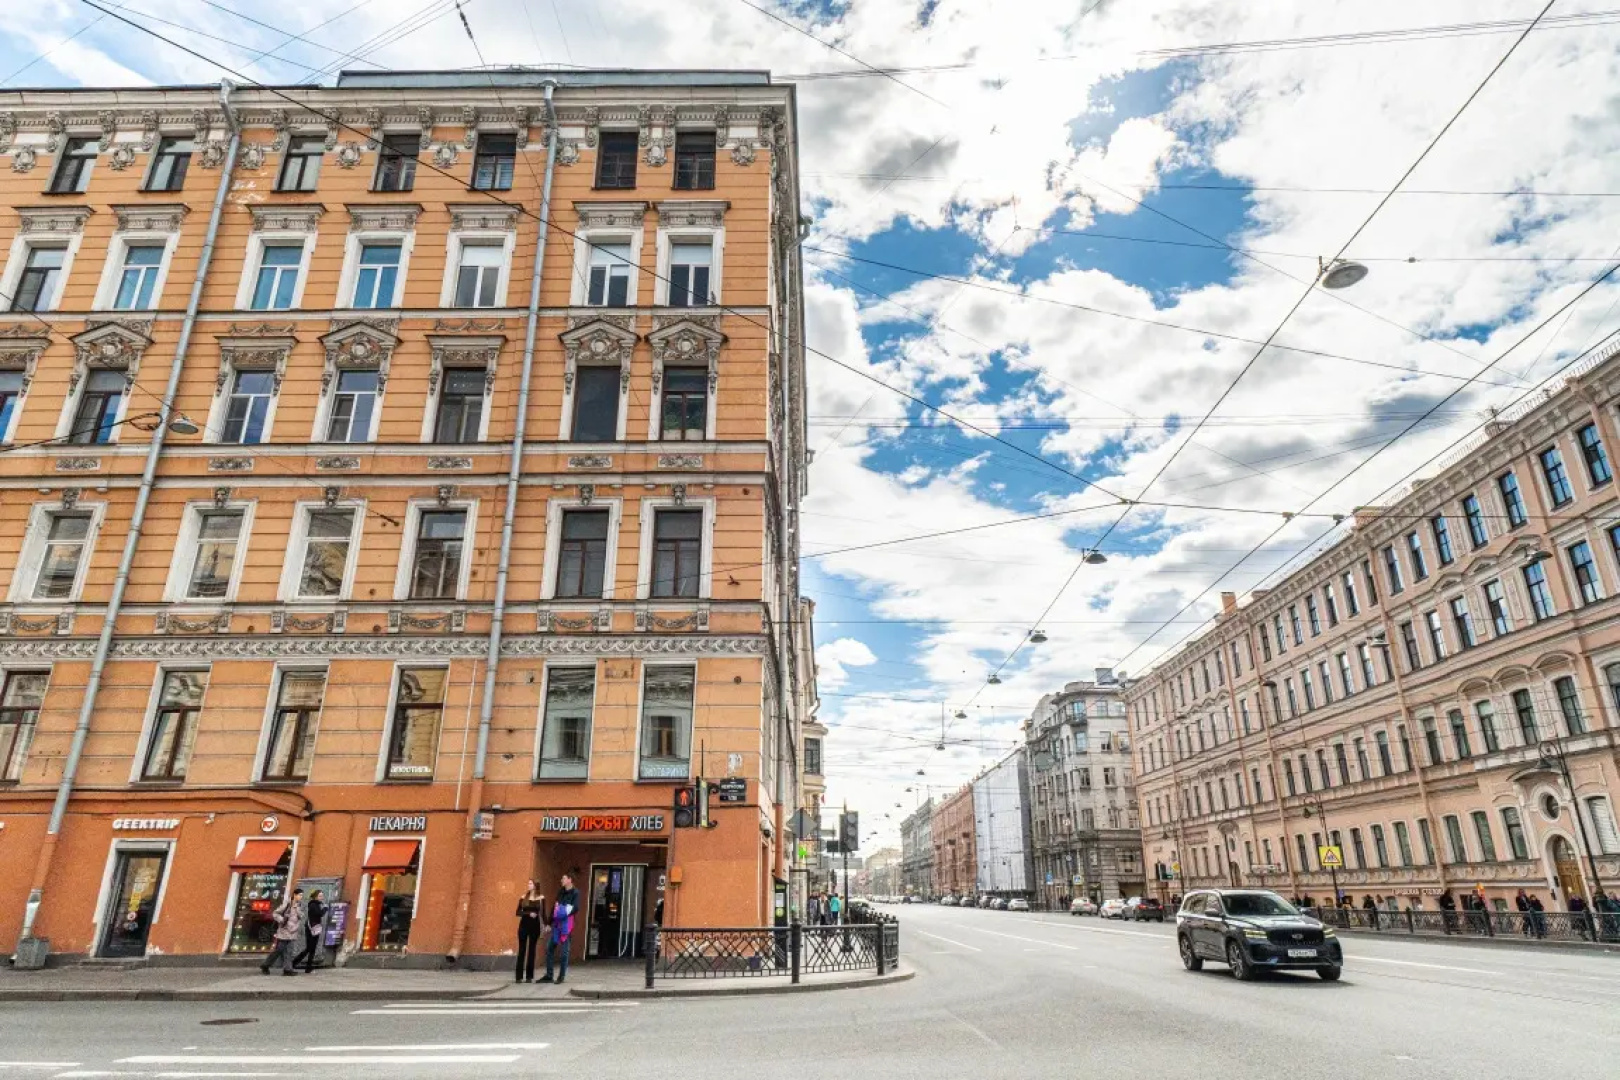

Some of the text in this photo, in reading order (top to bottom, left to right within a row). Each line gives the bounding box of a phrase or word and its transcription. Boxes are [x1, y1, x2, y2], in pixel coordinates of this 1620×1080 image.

[112, 818, 181, 830] GEEKTRIP
[369, 816, 426, 831] ПЕКАРНЯ
[540, 816, 579, 832] ЛЮДИ
[631, 815, 663, 830] ХЛЕБ
